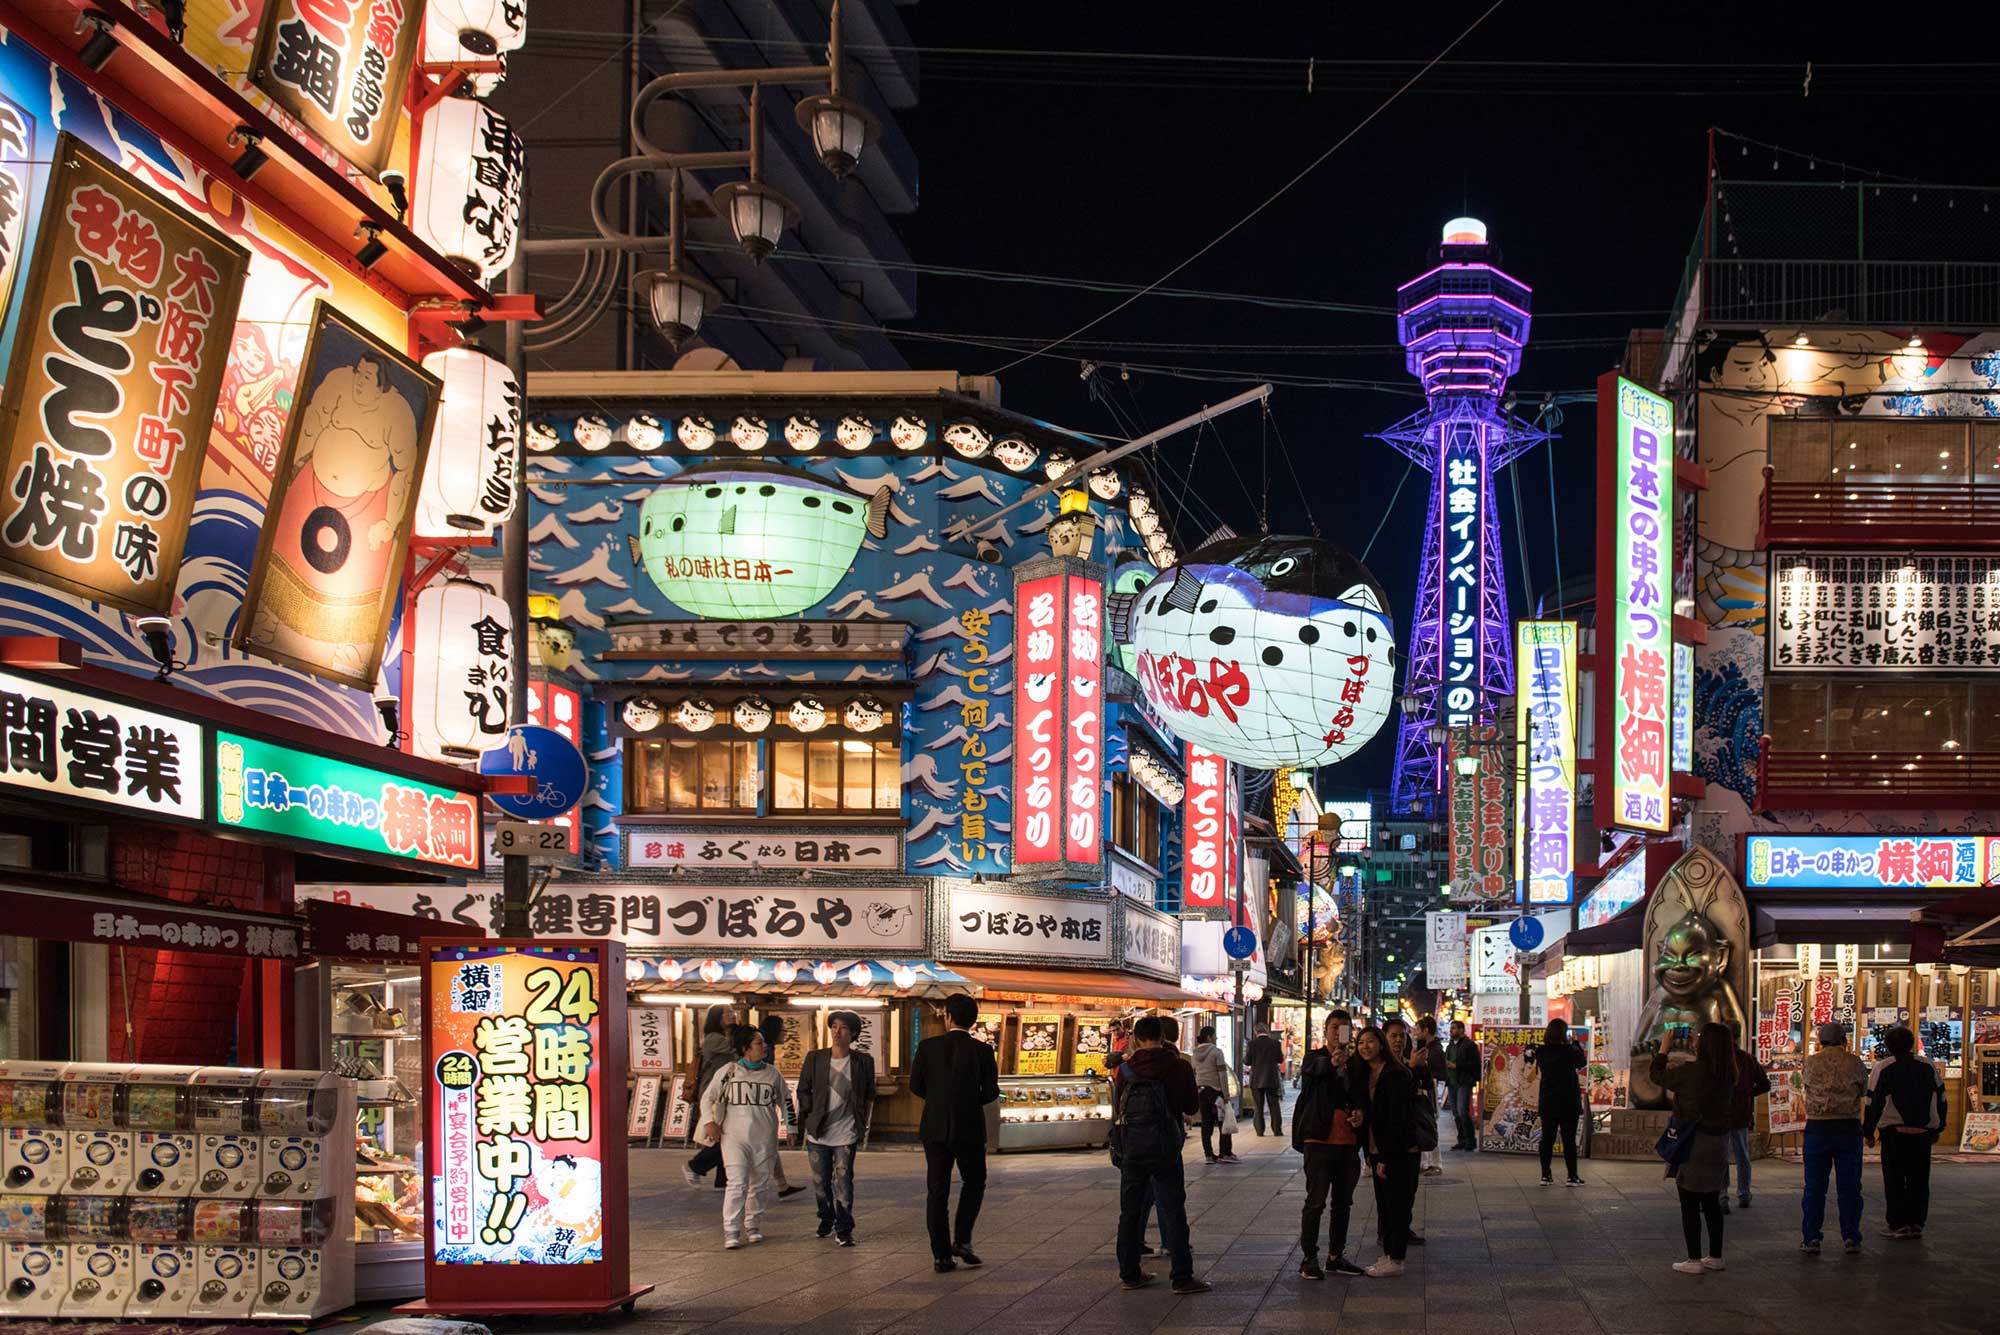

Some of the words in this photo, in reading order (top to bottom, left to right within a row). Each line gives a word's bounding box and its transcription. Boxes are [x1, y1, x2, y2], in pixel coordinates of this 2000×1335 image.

[68, 188, 164, 282] 名物
[117, 252, 219, 580] 大阪下町の味
[1629, 427, 1660, 641] 日本一の串かつ
[664, 556, 794, 583] 私の味は日本一
[1026, 592, 1056, 662] 名物
[1071, 592, 1098, 662] 名物
[1779, 610, 1794, 665] もち
[1796, 610, 1813, 665] うずら玉子
[1814, 610, 1830, 665] 紅しょうが
[1830, 610, 1847, 665] にんにく
[1848, 610, 1865, 665] 玉ねぎ
[1866, 610, 1882, 665] 山芋
[1883, 610, 1899, 665] しし唐
[1901, 610, 1917, 665] れんこん
[1918, 610, 1935, 665] 銀杏
[1936, 610, 1952, 665] 白ねぎ
[1953, 610, 1969, 665] さつま芋
[1970, 610, 1987, 665] じゃが芋
[1322, 652, 1373, 749] づぼらや
[1530, 648, 1563, 783] 日本一の串かつ
[1620, 643, 1666, 788] 横綱
[0, 690, 182, 806] 間営業
[960, 607, 991, 863] 安うて何んでも旨い
[245, 771, 377, 827] 日本一の串かつ
[380, 783, 475, 863] 横綱
[1624, 792, 1662, 824] 酒処
[502, 830, 514, 847] 9
[539, 832, 566, 850] 22
[643, 841, 688, 860] 珍味
[1771, 850, 1874, 875] 日本一の串かつ
[1877, 841, 1953, 884] 横綱
[1955, 842, 1976, 884] 酒処
[93, 912, 239, 949] 日本一の串かつ
[246, 924, 298, 957] 横綱
[667, 895, 853, 940] づぼらや
[959, 912, 1101, 944] づぼらや本店
[460, 964, 491, 1012] 横綱
[1790, 981, 1805, 1023] ソースの
[1813, 976, 1833, 1025] お座敷
[1773, 989, 1791, 1047] 二度漬け
[443, 1056, 473, 1072] 24
[443, 1071, 473, 1086] 時間
[524, 966, 599, 1141] 24時間
